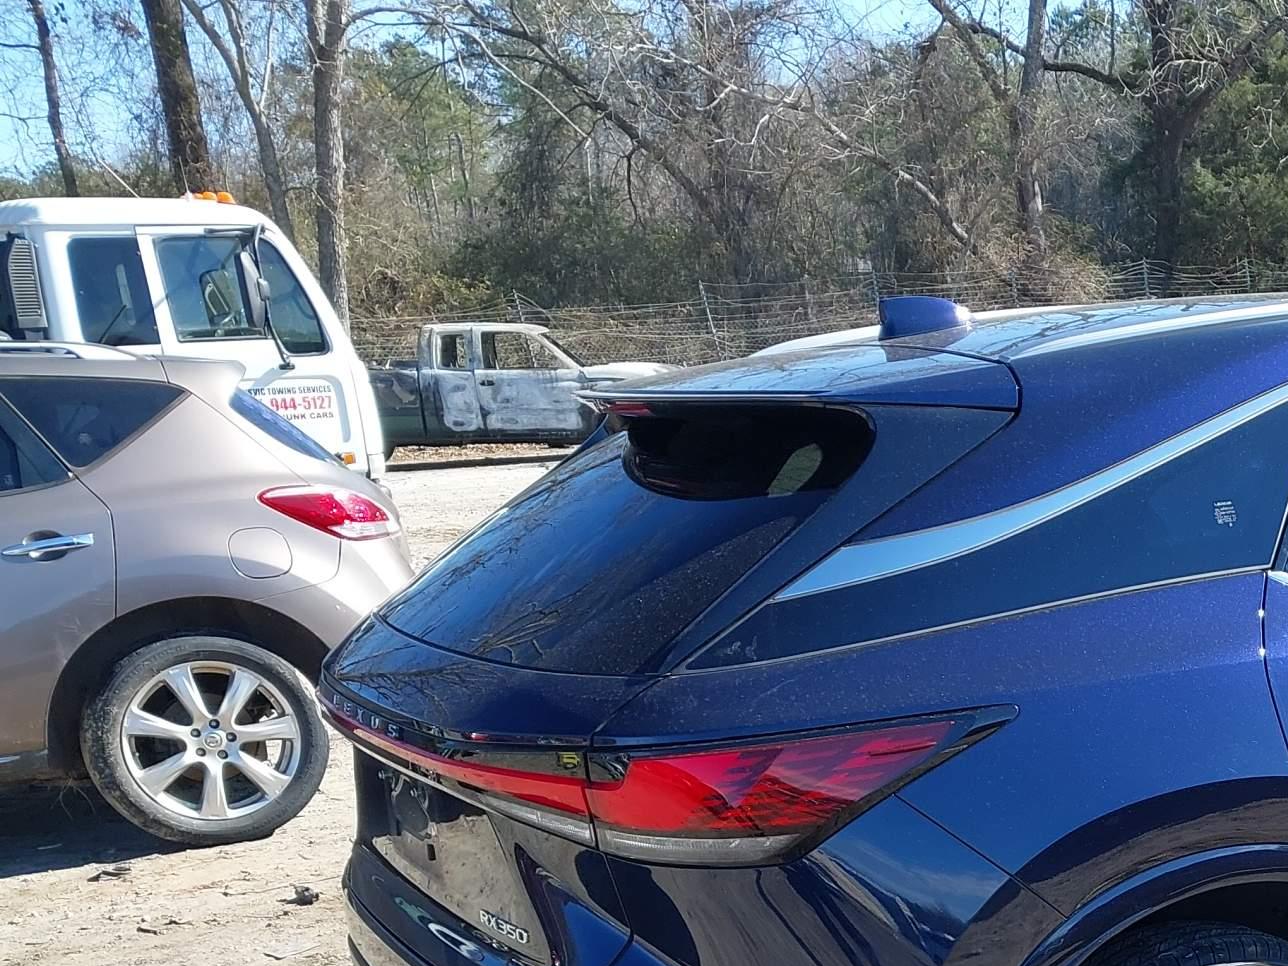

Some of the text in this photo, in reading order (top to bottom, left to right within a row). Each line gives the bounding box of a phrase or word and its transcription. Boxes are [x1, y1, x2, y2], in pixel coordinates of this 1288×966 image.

[267, 386, 297, 396] TOWING
[297, 385, 332, 394] SERVICES
[269, 395, 333, 412] 944-5127
[283, 411, 334, 421] UNK CARS
[333, 694, 400, 737] LEXUS
[479, 909, 529, 944] RX350
